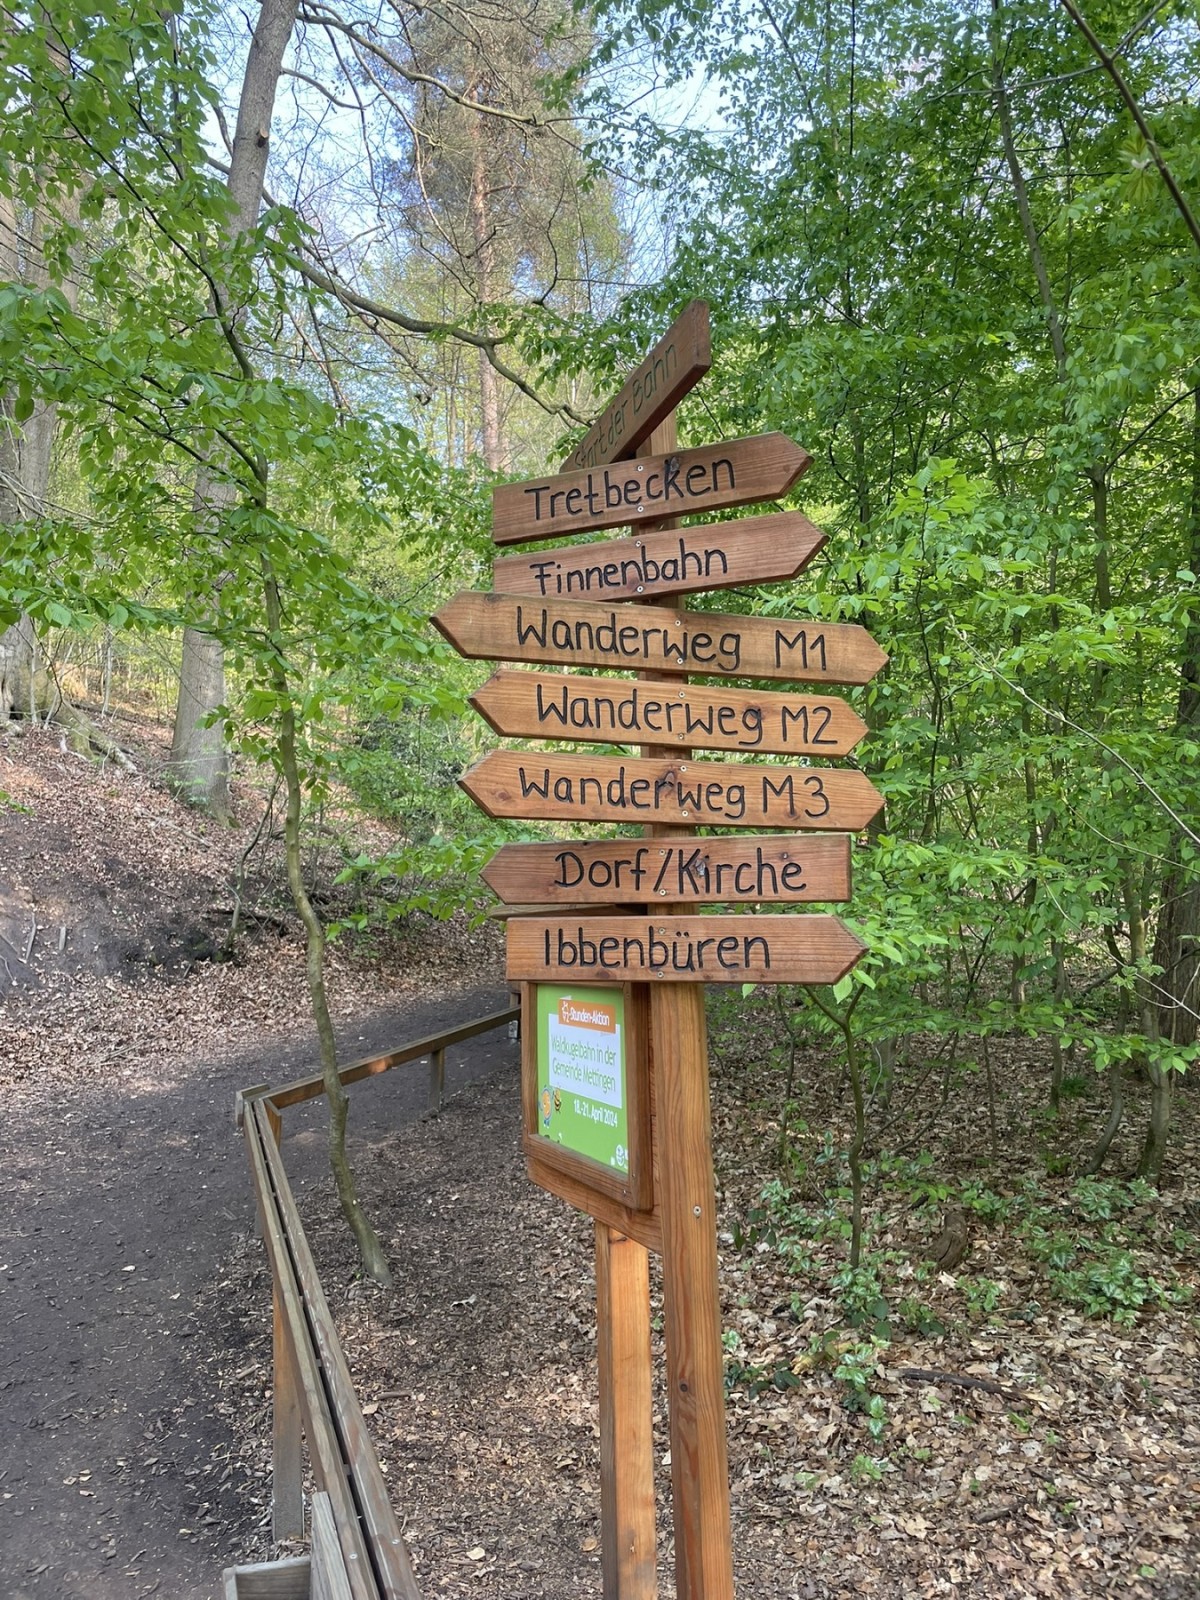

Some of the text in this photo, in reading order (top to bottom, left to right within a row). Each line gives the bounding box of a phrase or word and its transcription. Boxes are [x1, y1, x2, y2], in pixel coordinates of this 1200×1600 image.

[607, 399, 629, 447] der
[631, 343, 678, 416] Bahn
[524, 457, 736, 521] Tretbecken
[529, 538, 728, 595] Finnenbahn
[516, 605, 828, 672] Wanderweg M1
[536, 683, 838, 746] Wanderweg M2
[518, 766, 831, 819] Wanderweg M3
[554, 847, 807, 897] Dorf/Kirche
[544, 925, 771, 973] Ibbenbüren
[550, 1034, 617, 1067] Waldkugelbahn in der
[552, 1057, 616, 1095] Gemeinde Mettingen
[590, 1103, 603, 1124] April
[603, 1108, 618, 1128] 2024
